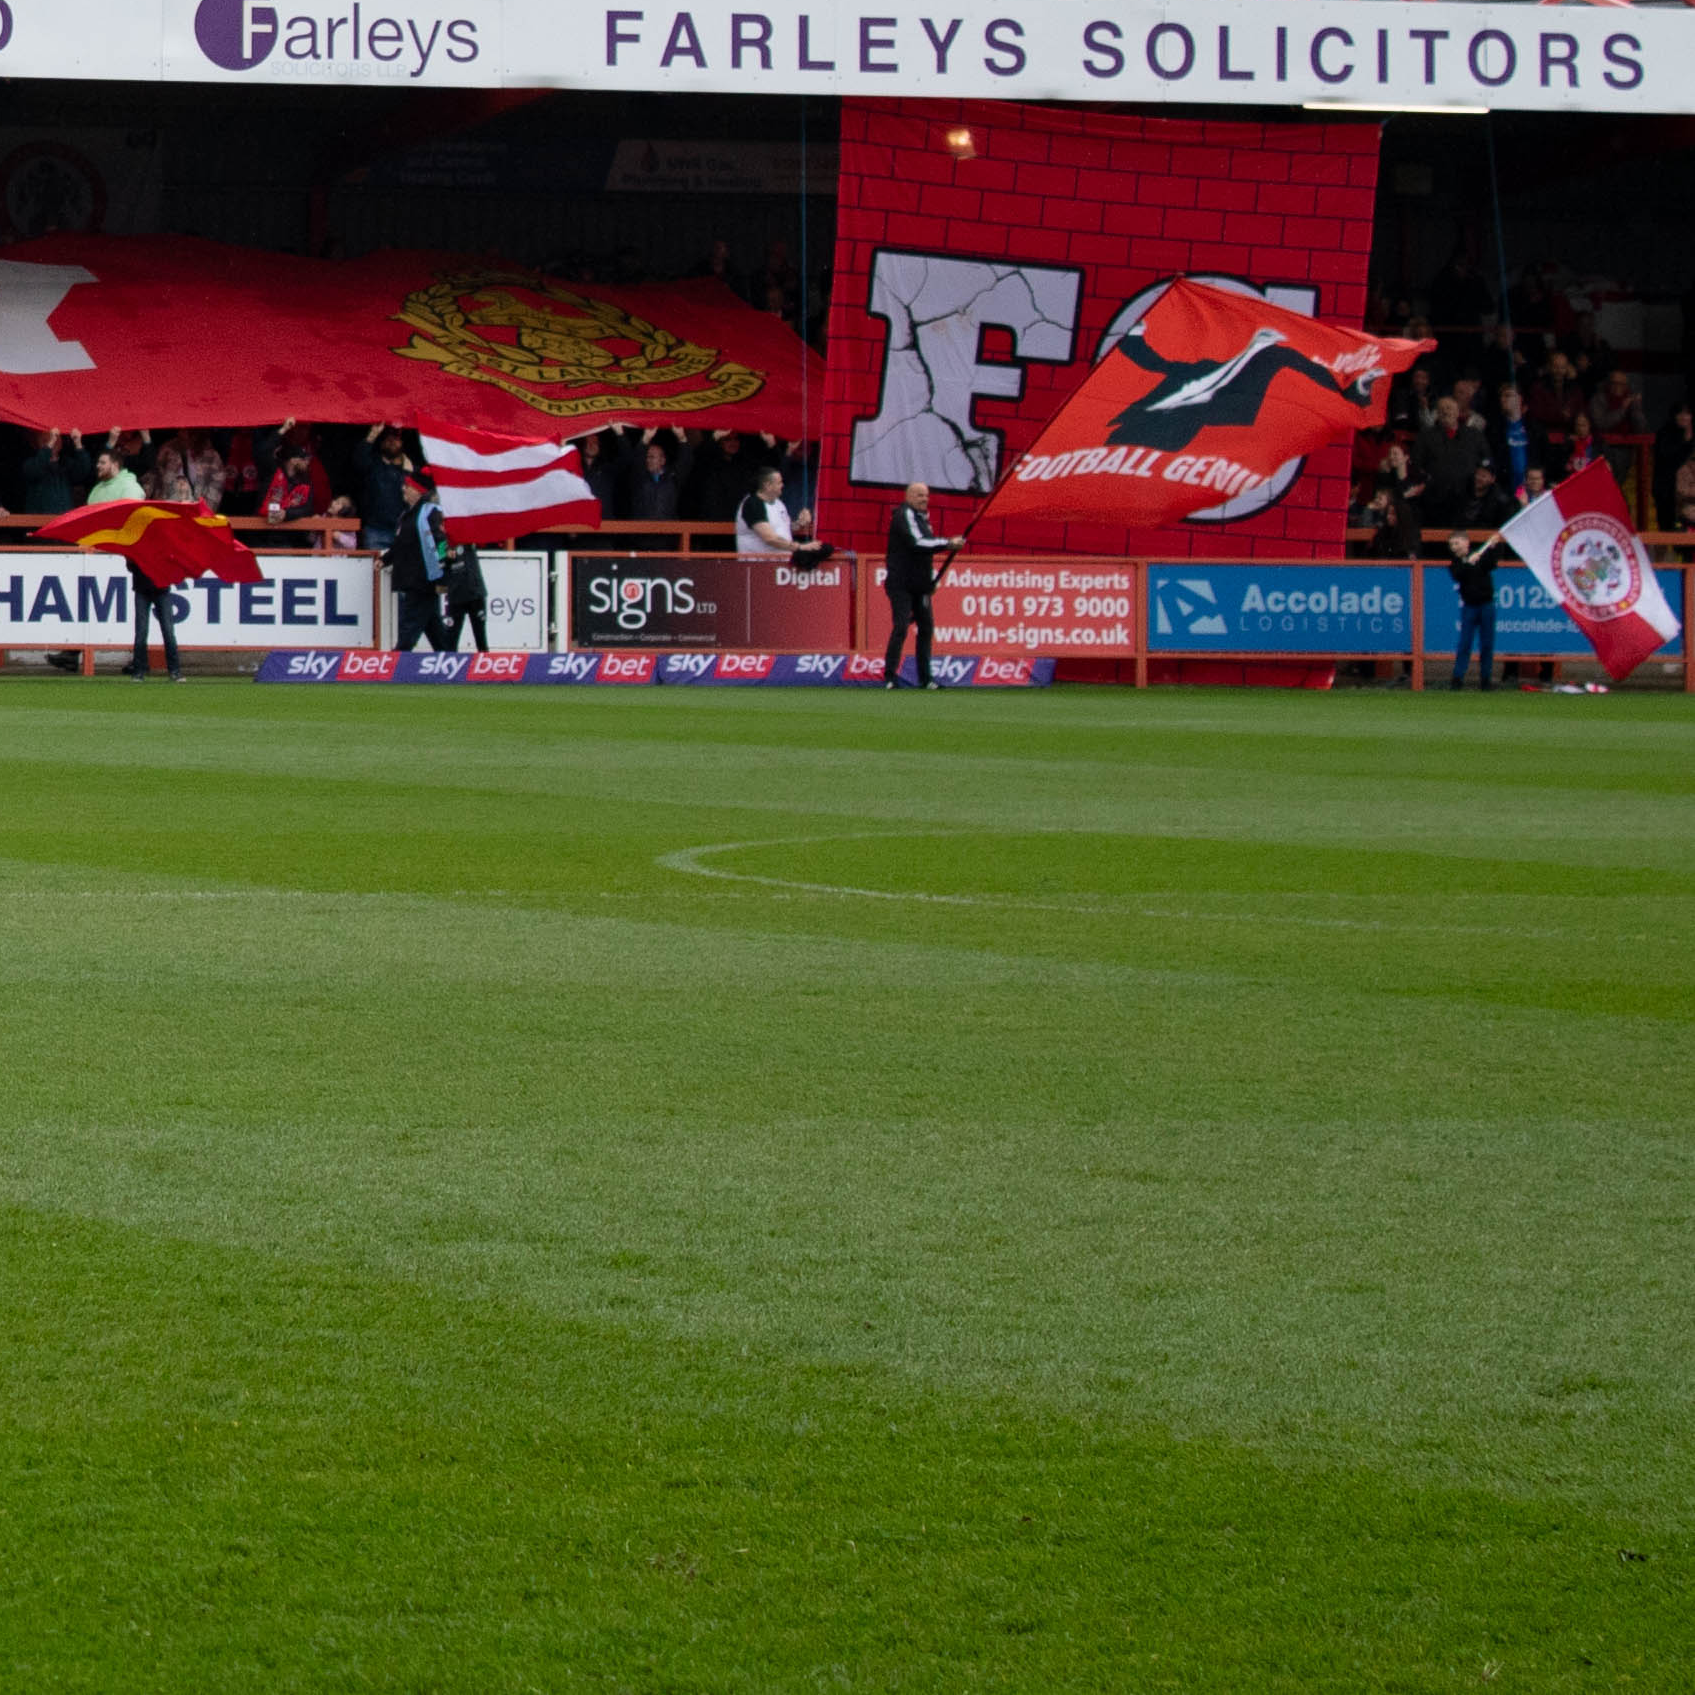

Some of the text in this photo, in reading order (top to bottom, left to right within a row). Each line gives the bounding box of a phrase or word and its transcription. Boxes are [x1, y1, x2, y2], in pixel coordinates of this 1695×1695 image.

[242, 0, 479, 78] Farleys
[607, 11, 1642, 89] FARLEYS SOLICITORS
[1014, 446, 1273, 495] FOOTBALL GENIU
[775, 566, 841, 589] Digital
[946, 569, 1055, 593] Advertising
[1059, 570, 1130, 593] Experts
[152, 575, 359, 627] STEEL
[589, 564, 717, 629] signs LTD
[962, 596, 1129, 618] 0161 973 9000
[1241, 583, 1404, 615] Accolade
[915, 623, 1129, 649] ww.in-signs.co.uk
[1240, 617, 1403, 633] LOGISTICS
[287, 652, 392, 680] sky bet
[418, 653, 521, 680] sky bet
[548, 653, 649, 680] sky bet
[666, 653, 768, 678] sky bet
[796, 654, 887, 679] sky be
[929, 655, 1029, 683] sky bet
